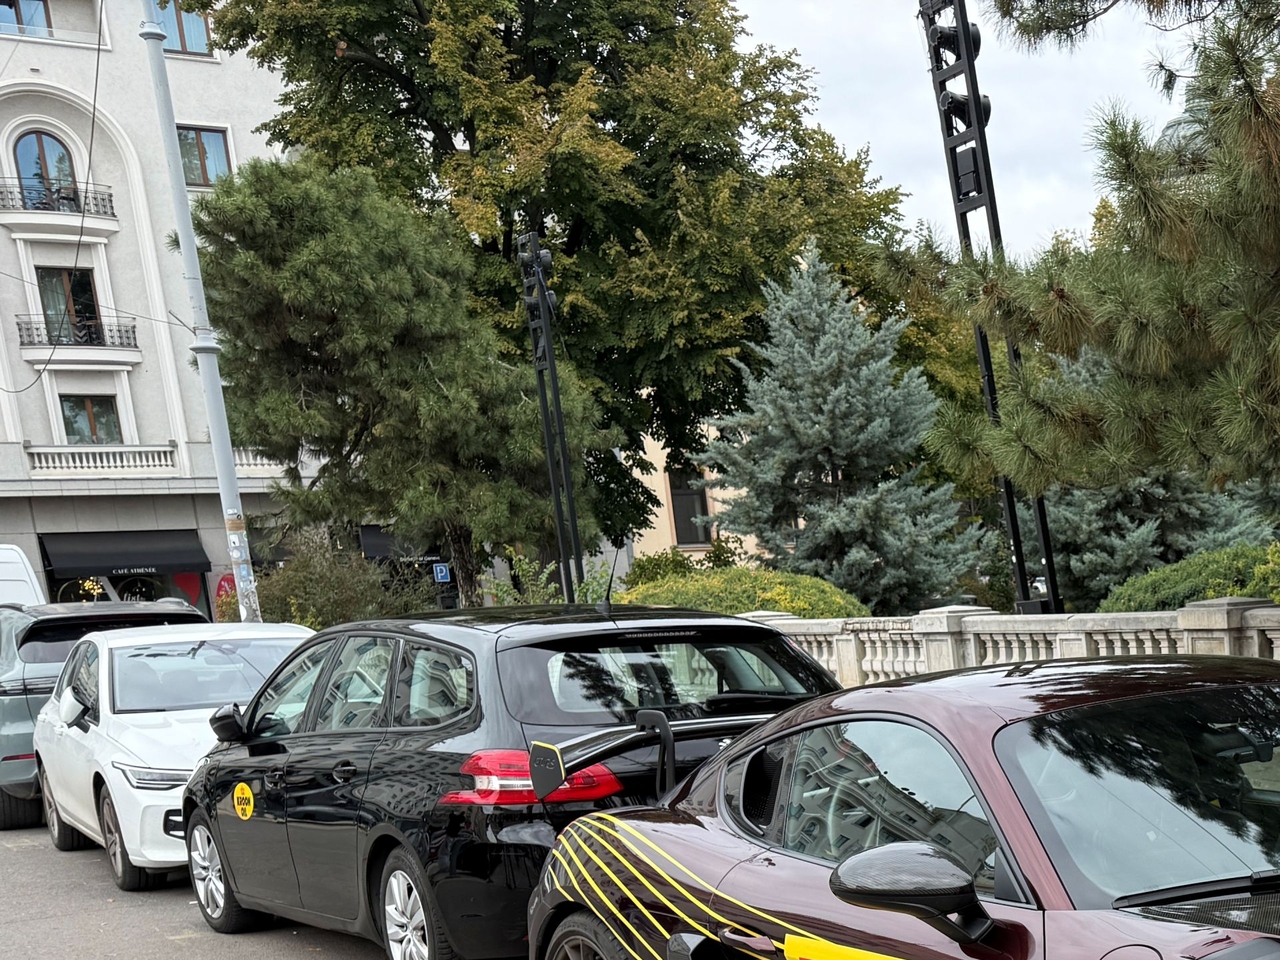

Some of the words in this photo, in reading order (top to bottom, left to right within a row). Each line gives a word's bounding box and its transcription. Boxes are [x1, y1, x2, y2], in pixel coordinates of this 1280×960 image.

[437, 566, 446, 580] P
[236, 796, 251, 806] KROON
[240, 807, 248, 817] OIL
